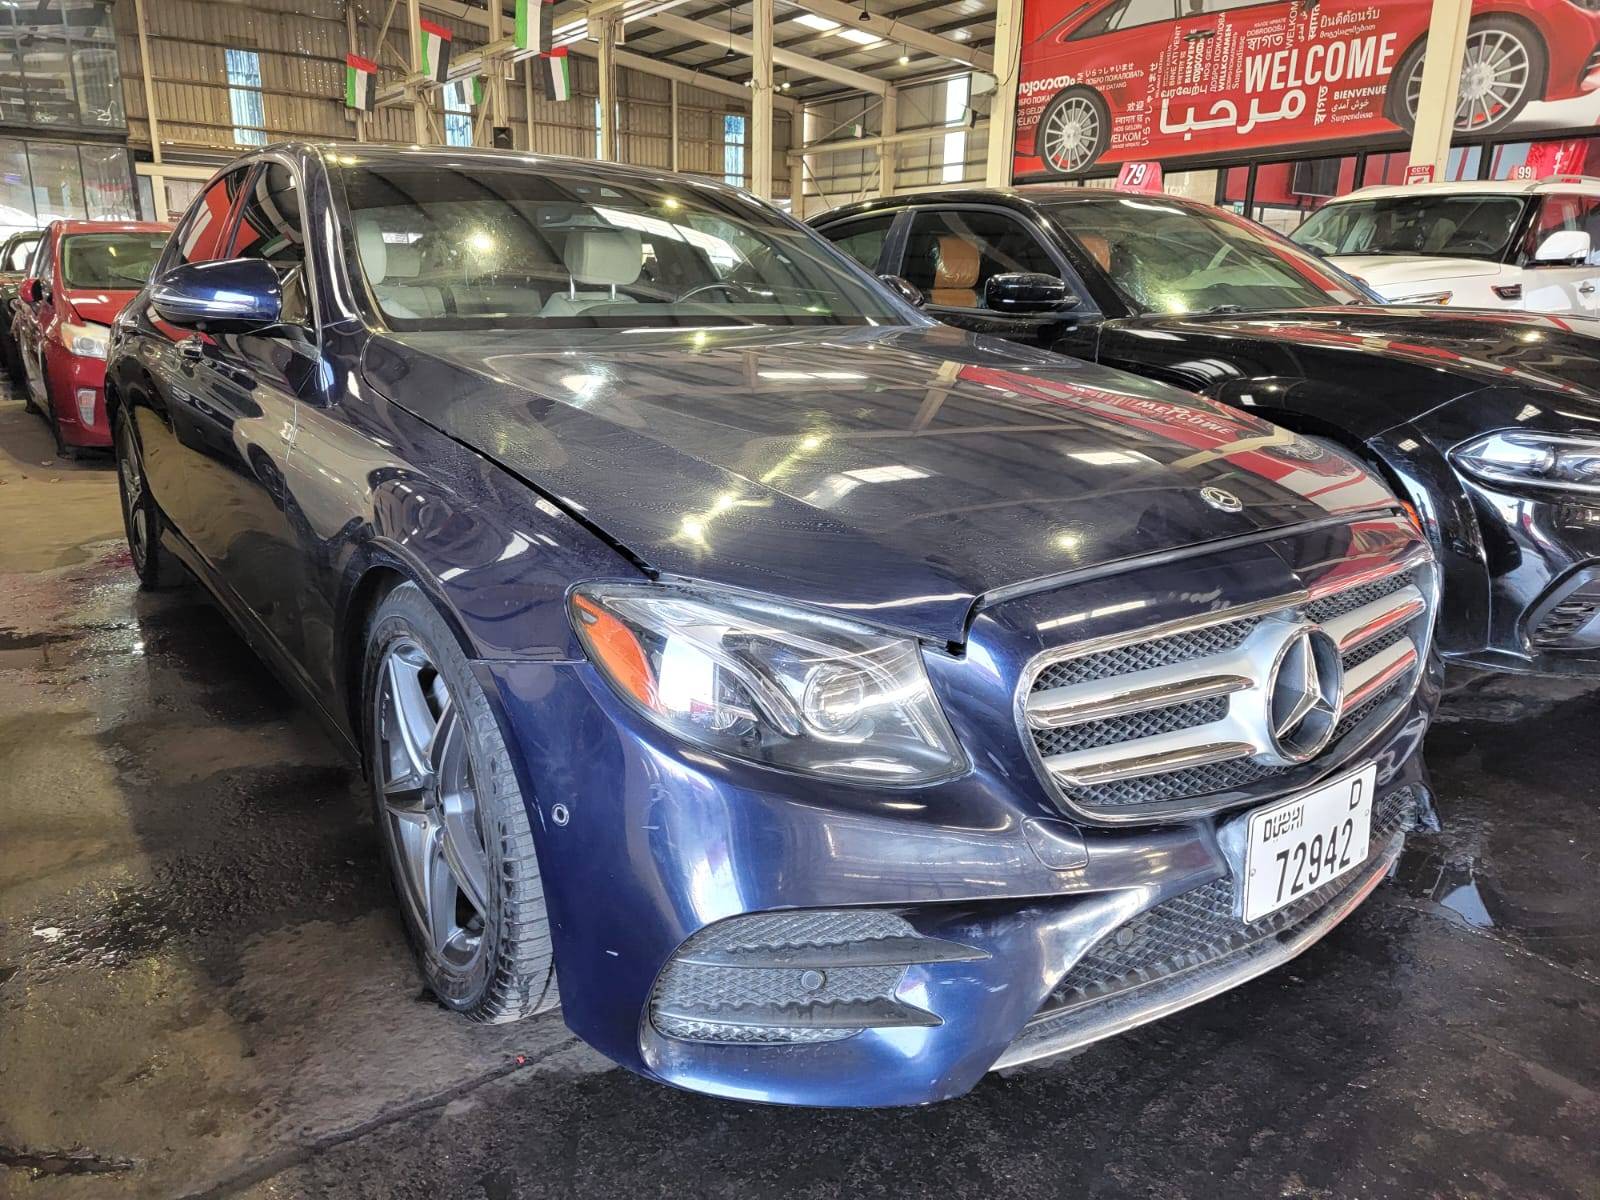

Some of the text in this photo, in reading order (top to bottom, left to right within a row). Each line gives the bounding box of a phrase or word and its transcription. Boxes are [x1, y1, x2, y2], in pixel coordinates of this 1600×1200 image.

[1205, 37, 1214, 60] GELD
[1285, 0, 1299, 49] WELKOM
[1185, 29, 1197, 83] BIENVENE
[1218, 24, 1233, 92] WILLKOMMEN
[1245, 32, 1398, 94] WELCOME
[1160, 88, 1306, 141] مرحبا
[1333, 85, 1388, 100] BIENVENUE
[1123, 163, 1147, 185] 79
[1518, 166, 1531, 179] 99
[1349, 778, 1363, 811] D
[1276, 818, 1353, 903] 72942
